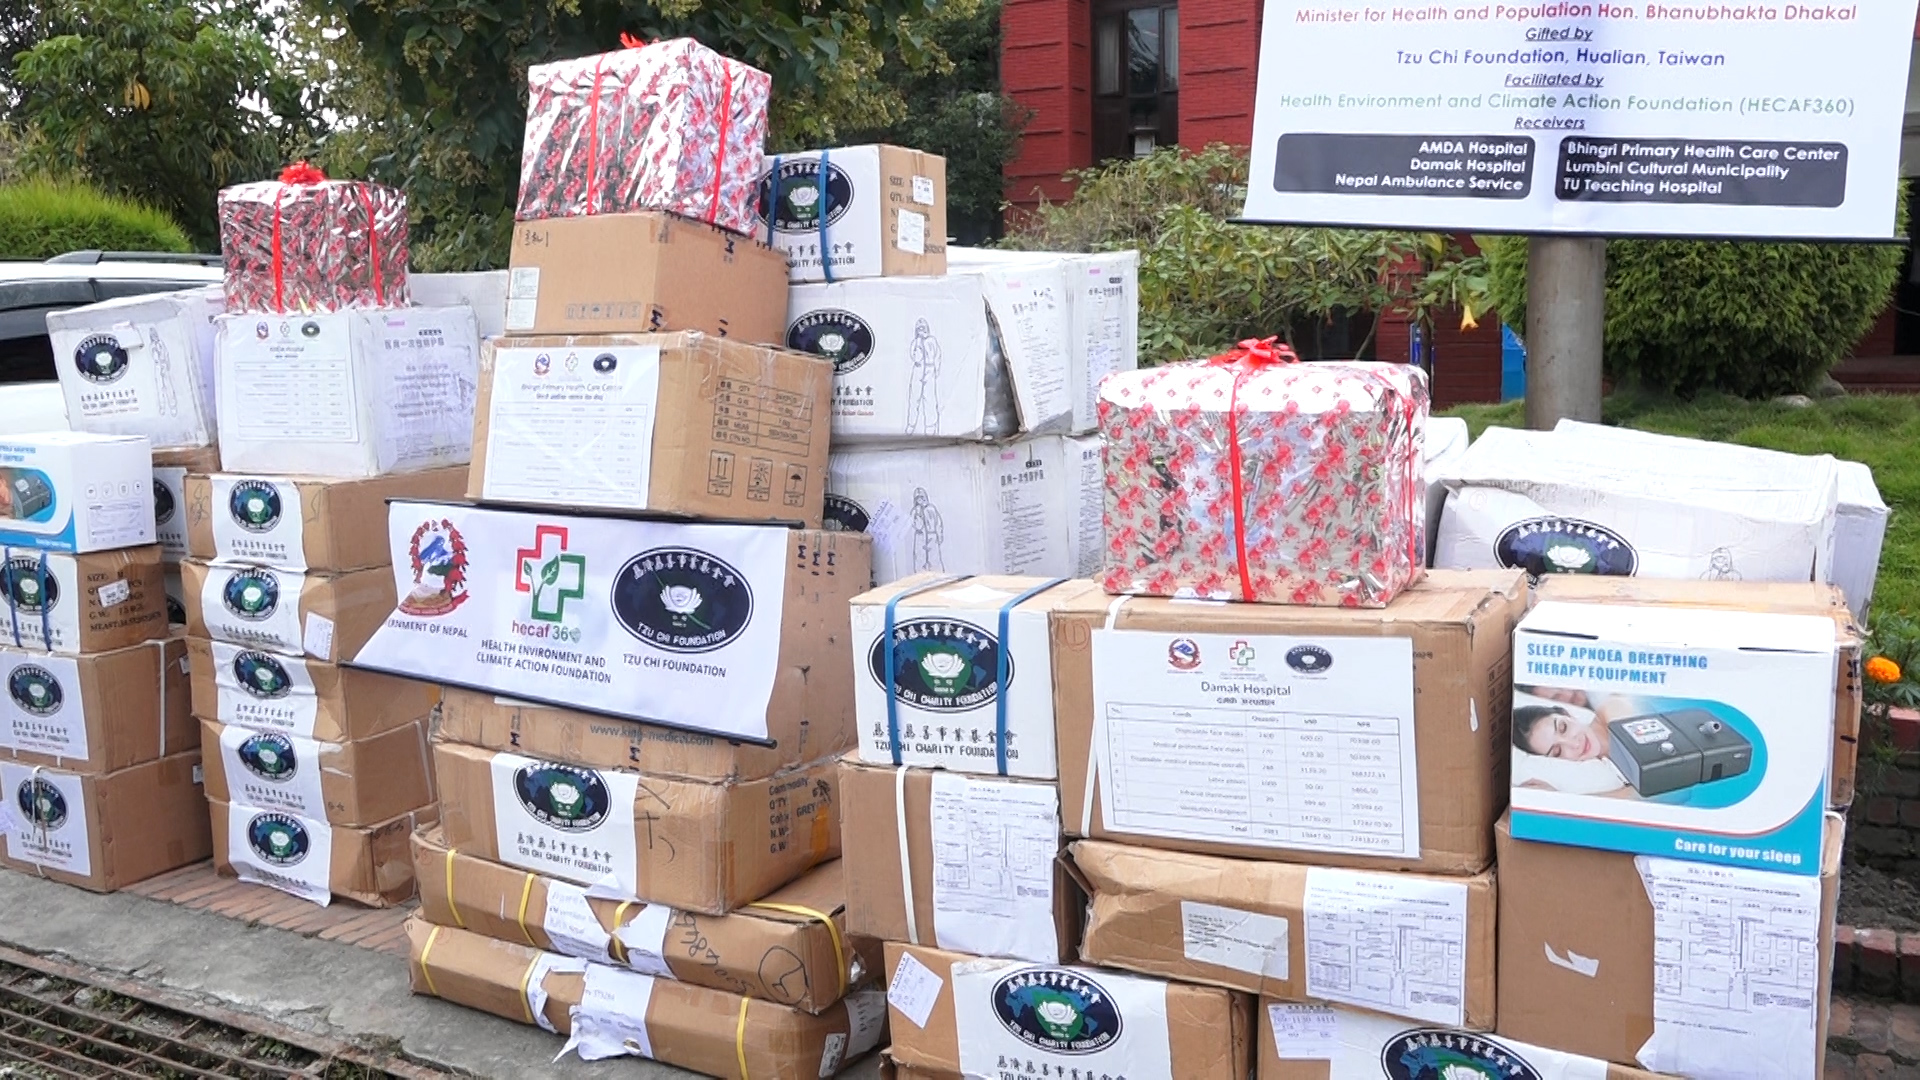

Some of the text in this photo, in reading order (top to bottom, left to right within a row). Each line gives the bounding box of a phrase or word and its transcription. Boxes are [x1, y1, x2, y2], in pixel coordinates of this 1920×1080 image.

[1296, 2, 1857, 23] Minister for Health and Population Hon. Bhanubhakta Dhakal
[1525, 27, 1593, 42] Gifted by
[1397, 48, 1725, 66] Tzu Chi Foundation, Hualian, Taiwan
[1504, 73, 1605, 88] Facilitated by
[1280, 93, 1855, 117] Health Environment and Climate Action Foundation (HECAF360)
[1514, 116, 1585, 131] Receivers
[1419, 142, 1528, 158] AMDA Hospital
[1567, 142, 1840, 161] Bhingri Primary Health Care Center
[1410, 158, 1526, 175] Damak Hospital
[1565, 159, 1790, 180] Lumbini Cultural Municipality
[1335, 174, 1524, 192] Nepal Ambulance Service
[1564, 180, 1723, 196] TU Teaching Hospital
[429, 624, 441, 634] OF
[442, 626, 468, 638] NEPAL
[511, 619, 550, 638] hecaf
[673, 629, 726, 646] FOUNDATION
[481, 639, 606, 668] HEALTH ENVIRONMENT AND
[1527, 643, 1708, 669] SLEEP APNOEA BREATHING
[476, 652, 611, 684] CLIMATE ACTION FOUNDATION
[623, 653, 727, 678] TZU CHI FOUNDATION
[1526, 661, 1667, 684] THERAPY EQUIPMENT
[1201, 681, 1291, 696] Damak Hospital
[915, 743, 954, 756] CHARITY
[959, 745, 1019, 760] FOUNDAON
[1675, 837, 1802, 866] Care for your sleep
